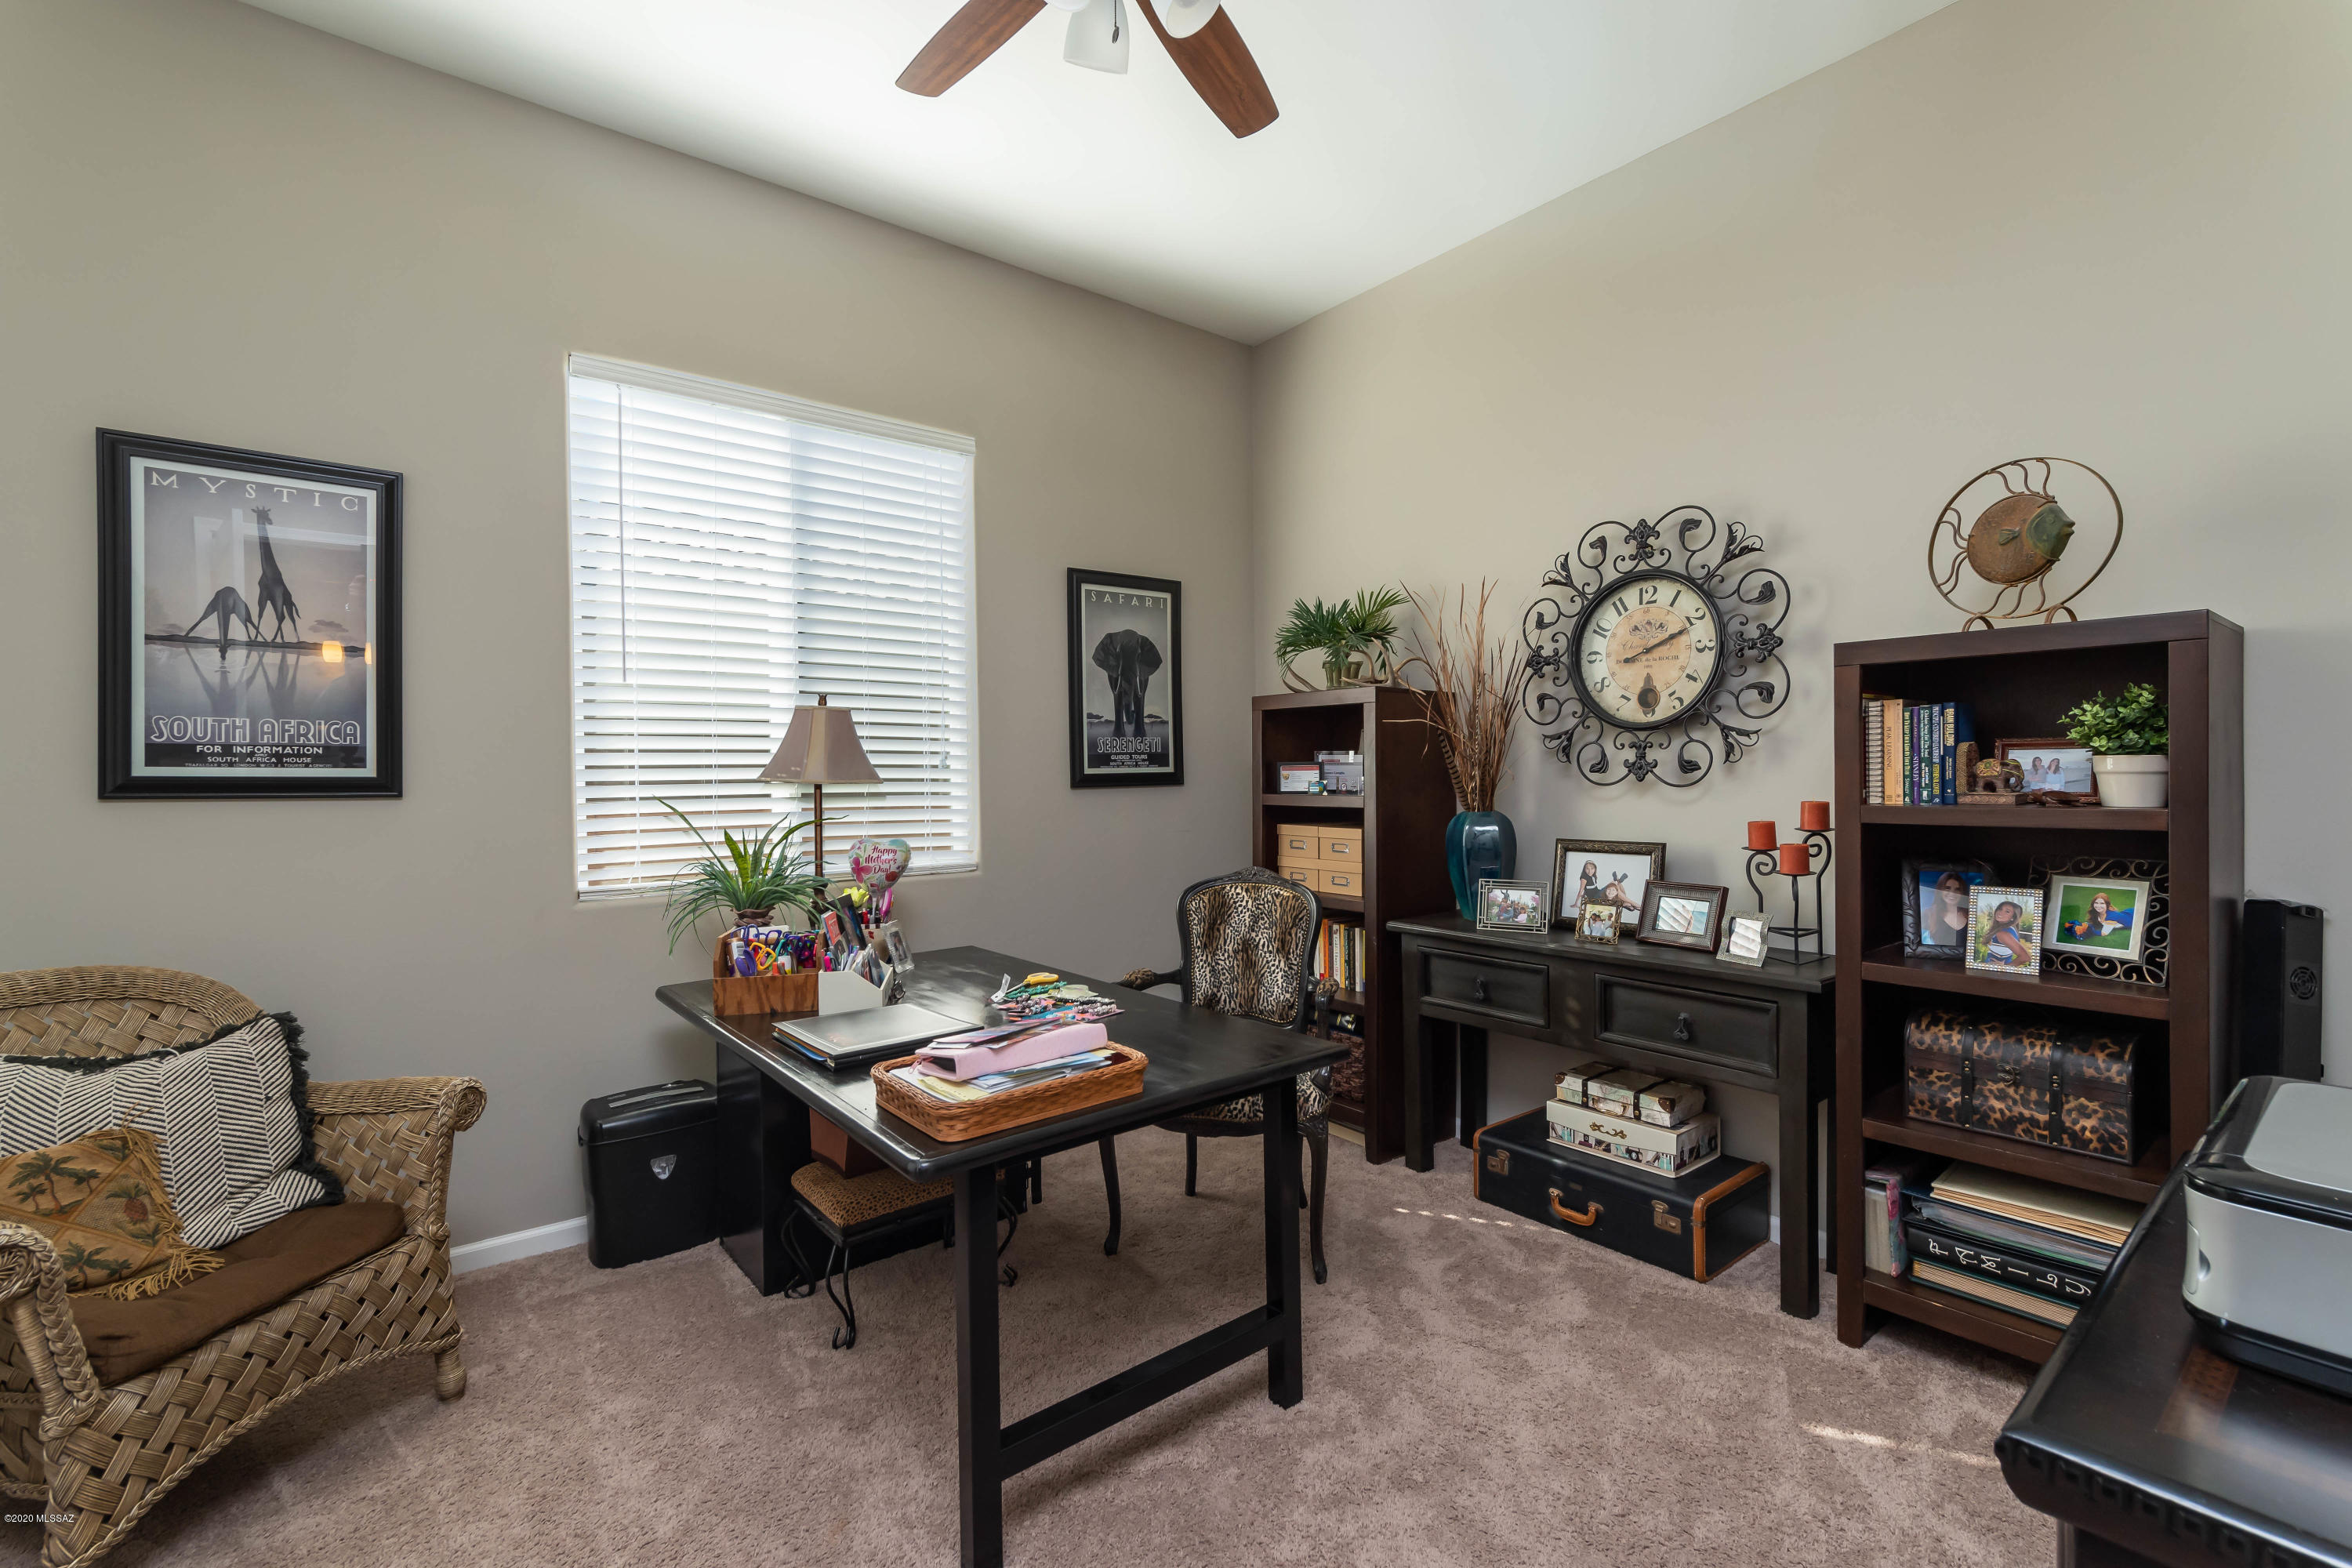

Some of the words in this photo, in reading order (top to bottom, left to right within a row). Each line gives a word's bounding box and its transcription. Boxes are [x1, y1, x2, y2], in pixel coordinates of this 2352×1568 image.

[150, 470, 358, 512] MYSTIC
[1091, 590, 1163, 609] SAFARI
[1639, 585, 1658, 605] 12
[1668, 590, 1682, 608] 1
[1612, 597, 1630, 617] 11
[1685, 607, 1706, 627] 2
[1592, 618, 1613, 639] 10
[1695, 639, 1715, 654] 3
[1587, 651, 1603, 664] 9
[1594, 677, 1610, 693] 8
[1686, 670, 1703, 684] 4
[1617, 694, 1632, 712] 7
[1668, 690, 1684, 710] 5
[1946, 708, 1955, 723] BRAIN
[151, 715, 250, 743] SOUTH
[258, 718, 361, 745] AFRICA
[1946, 724, 1955, 746] BUILDING
[196, 745, 223, 753] FOR
[233, 746, 323, 754] INFORMATION
[1098, 737, 1161, 753] SERENGETI
[865, 855, 898, 865] Mother's
[872, 845, 898, 857] Happy
[872, 864, 891, 874] Day!
[1928, 1238, 2092, 1297] FAMILY
